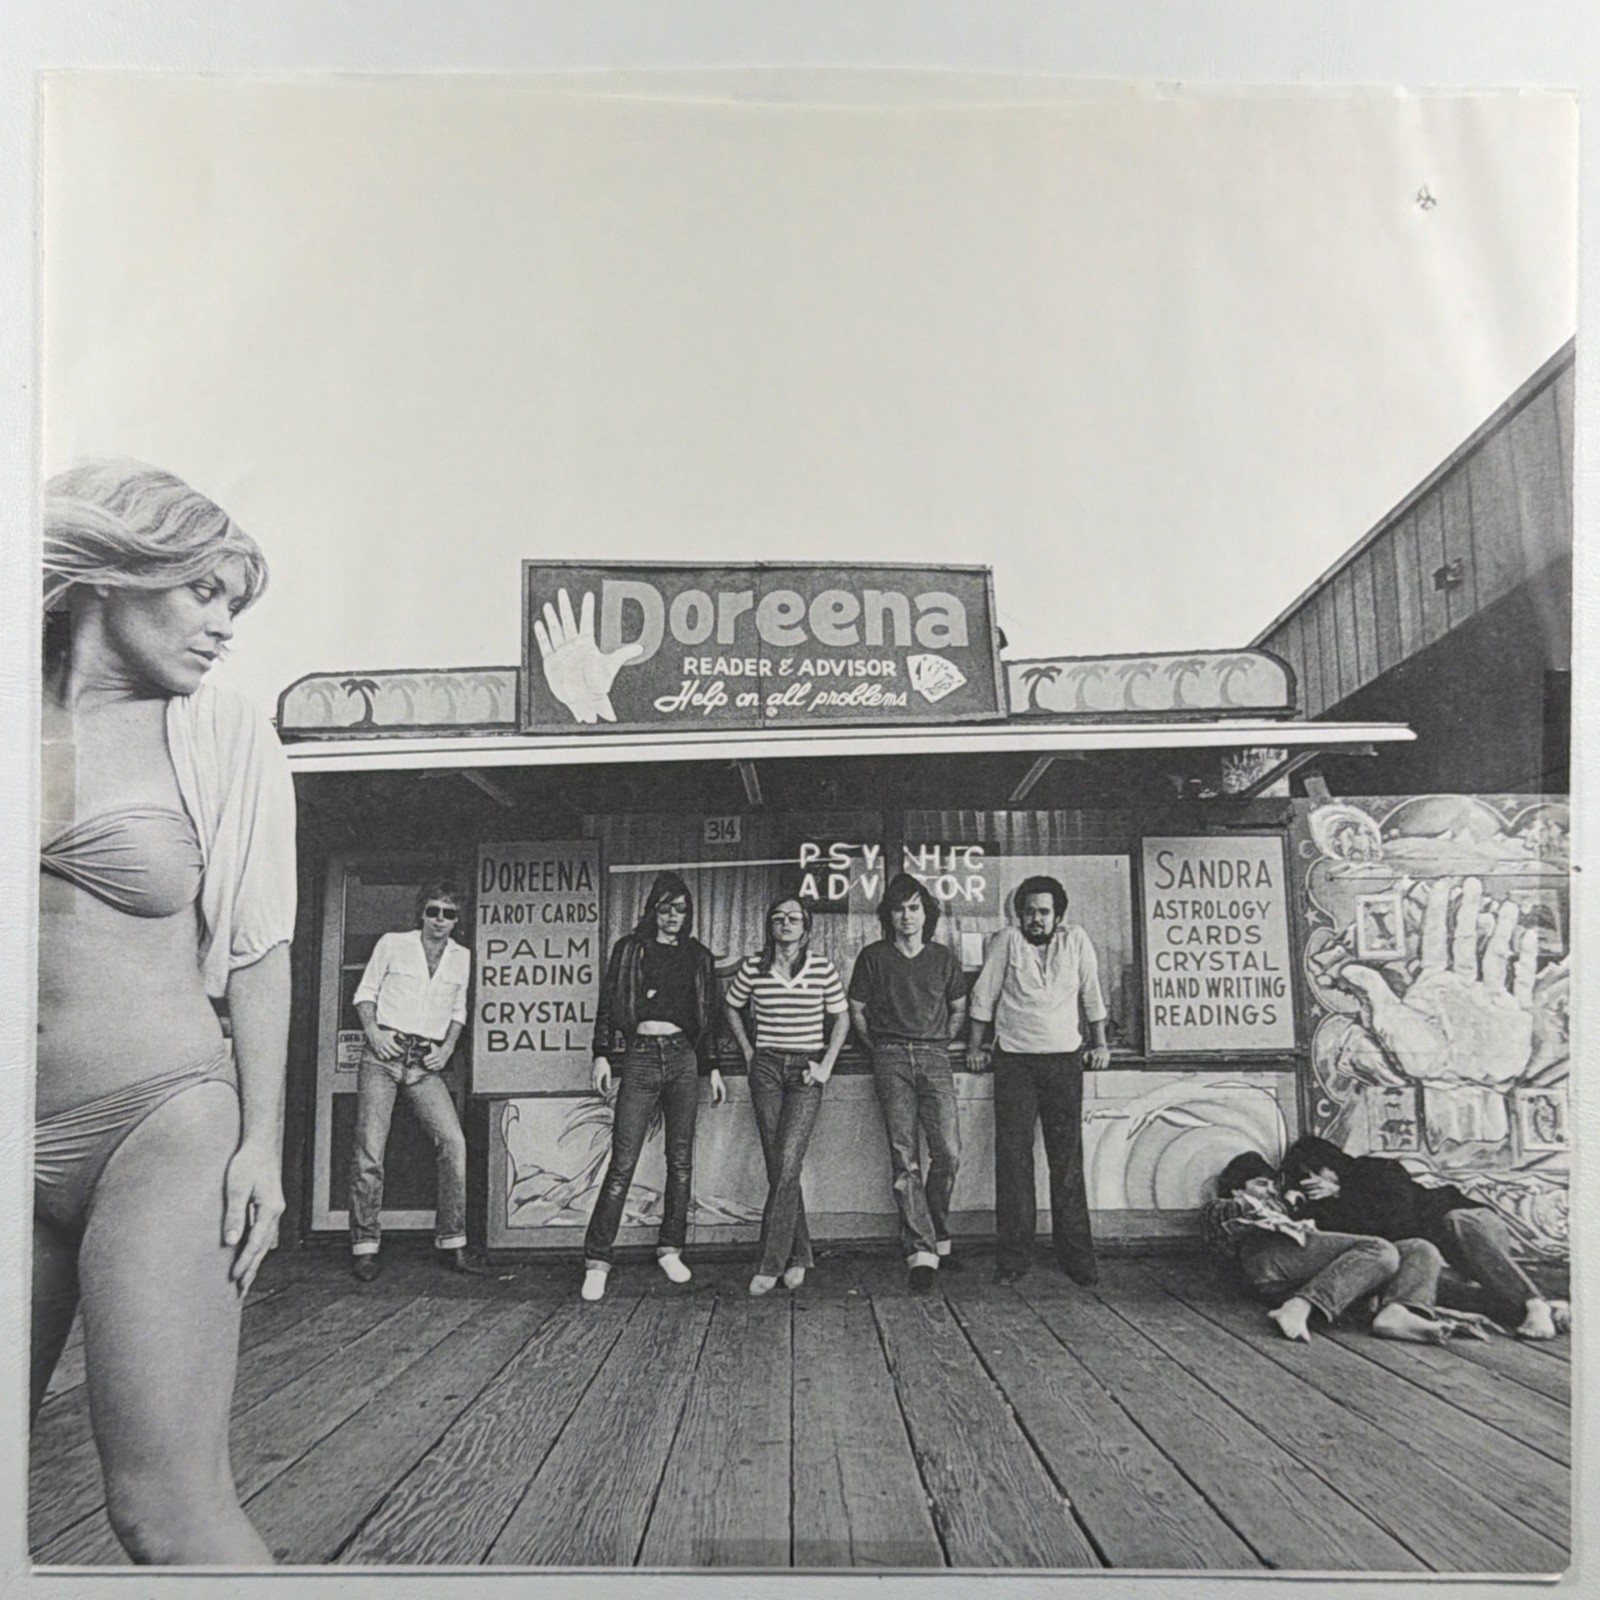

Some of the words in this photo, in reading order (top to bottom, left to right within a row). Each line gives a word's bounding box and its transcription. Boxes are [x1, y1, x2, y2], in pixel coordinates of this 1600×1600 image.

[601, 579, 969, 665] Doreena
[683, 656, 773, 677] READER
[778, 657, 795, 677] &
[799, 658, 898, 678] ADVISOR
[654, 680, 729, 715] Help
[735, 691, 760, 707] on
[766, 682, 813, 706] all
[807, 682, 908, 712] problems
[707, 819, 737, 840] 314
[800, 842, 985, 872] PSYHIC
[481, 857, 594, 893] DOREENA
[1154, 850, 1273, 890] SANDRA
[800, 872, 987, 902] ADVOR
[479, 903, 536, 925] TAROT
[541, 902, 598, 924] CARDS
[1152, 899, 1271, 920] ASTROLOGY
[1166, 925, 1262, 945] CARDS
[486, 937, 590, 960] PALM
[1155, 950, 1280, 972] CRYSTAL
[481, 964, 593, 987] READING
[1152, 977, 1200, 999] HAND
[1205, 976, 1286, 999] WRITING
[481, 1001, 594, 1024] CRYSTAL
[1154, 1004, 1278, 1026] READINGS
[487, 1029, 587, 1052] BALL
